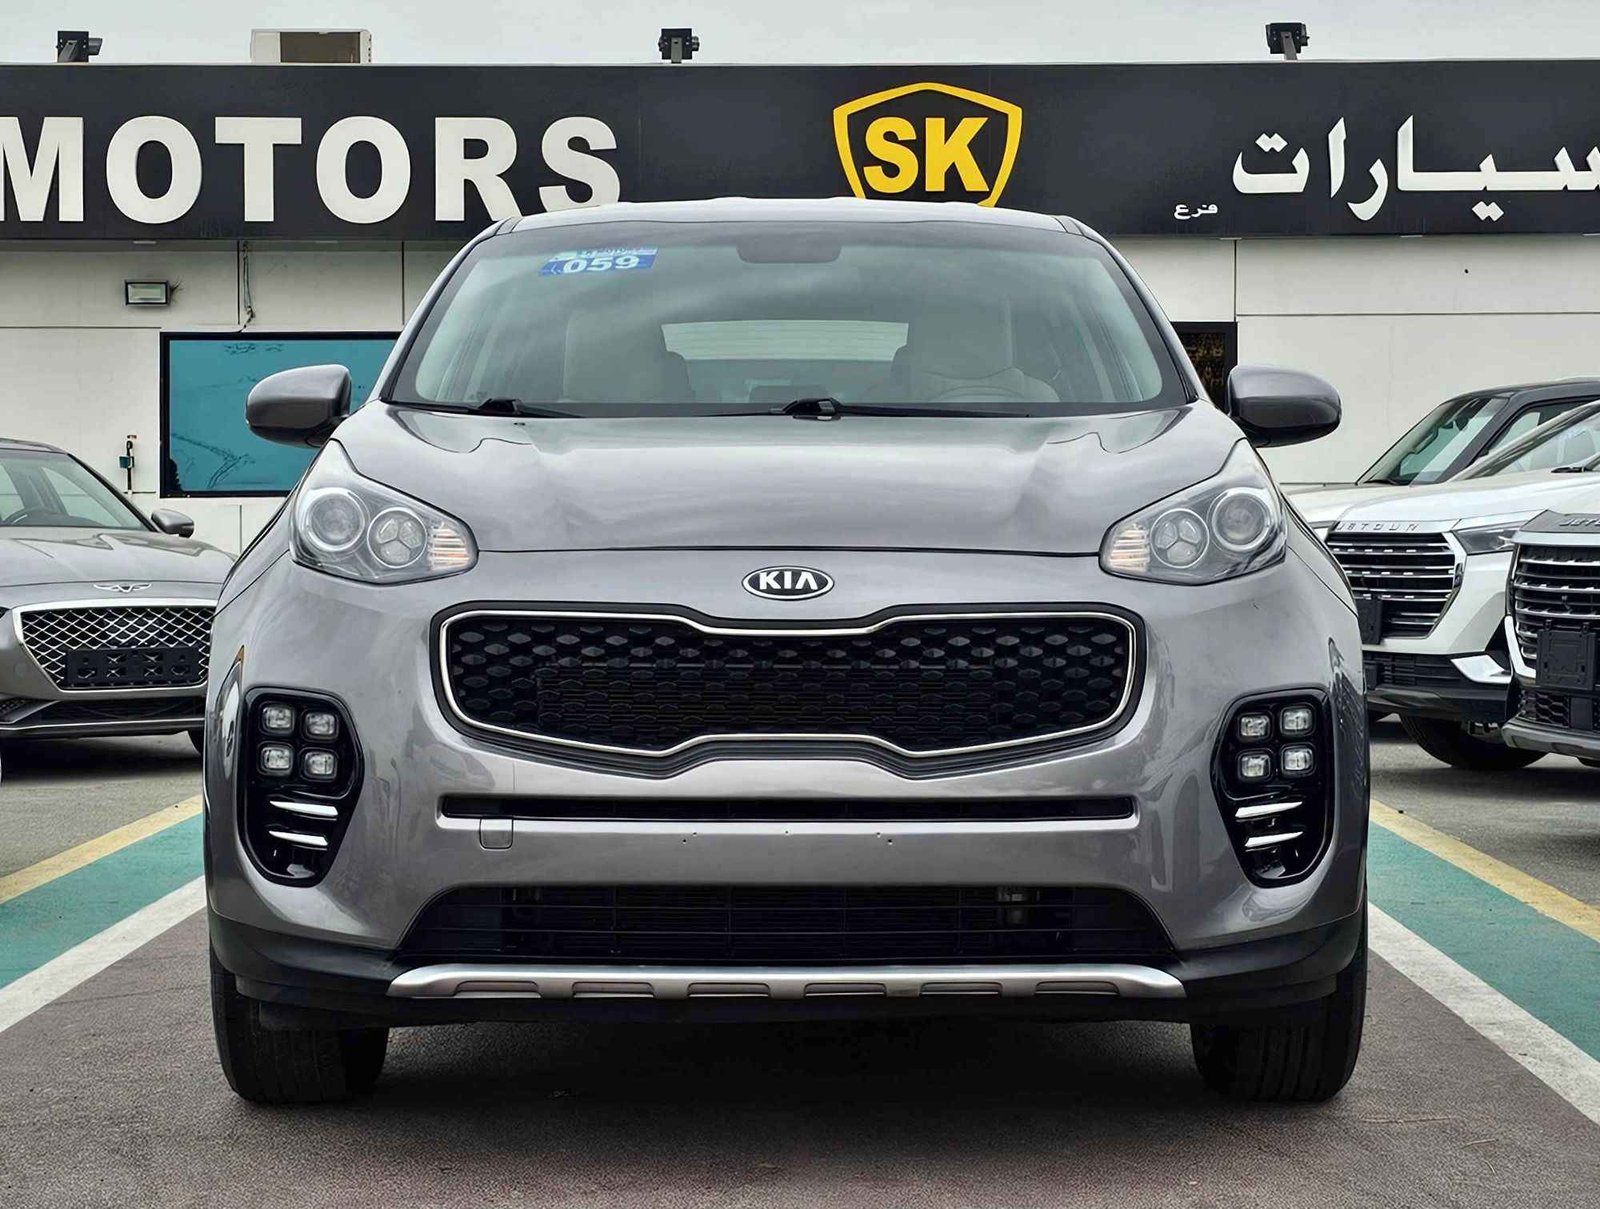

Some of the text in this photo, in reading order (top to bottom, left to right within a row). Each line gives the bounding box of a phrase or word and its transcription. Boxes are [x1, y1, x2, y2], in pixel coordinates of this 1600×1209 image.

[863, 116, 989, 194] SK
[0, 115, 621, 224] MOTORS
[1174, 203, 1218, 220] فرع
[563, 255, 640, 274] 059
[759, 571, 818, 590] KIA
